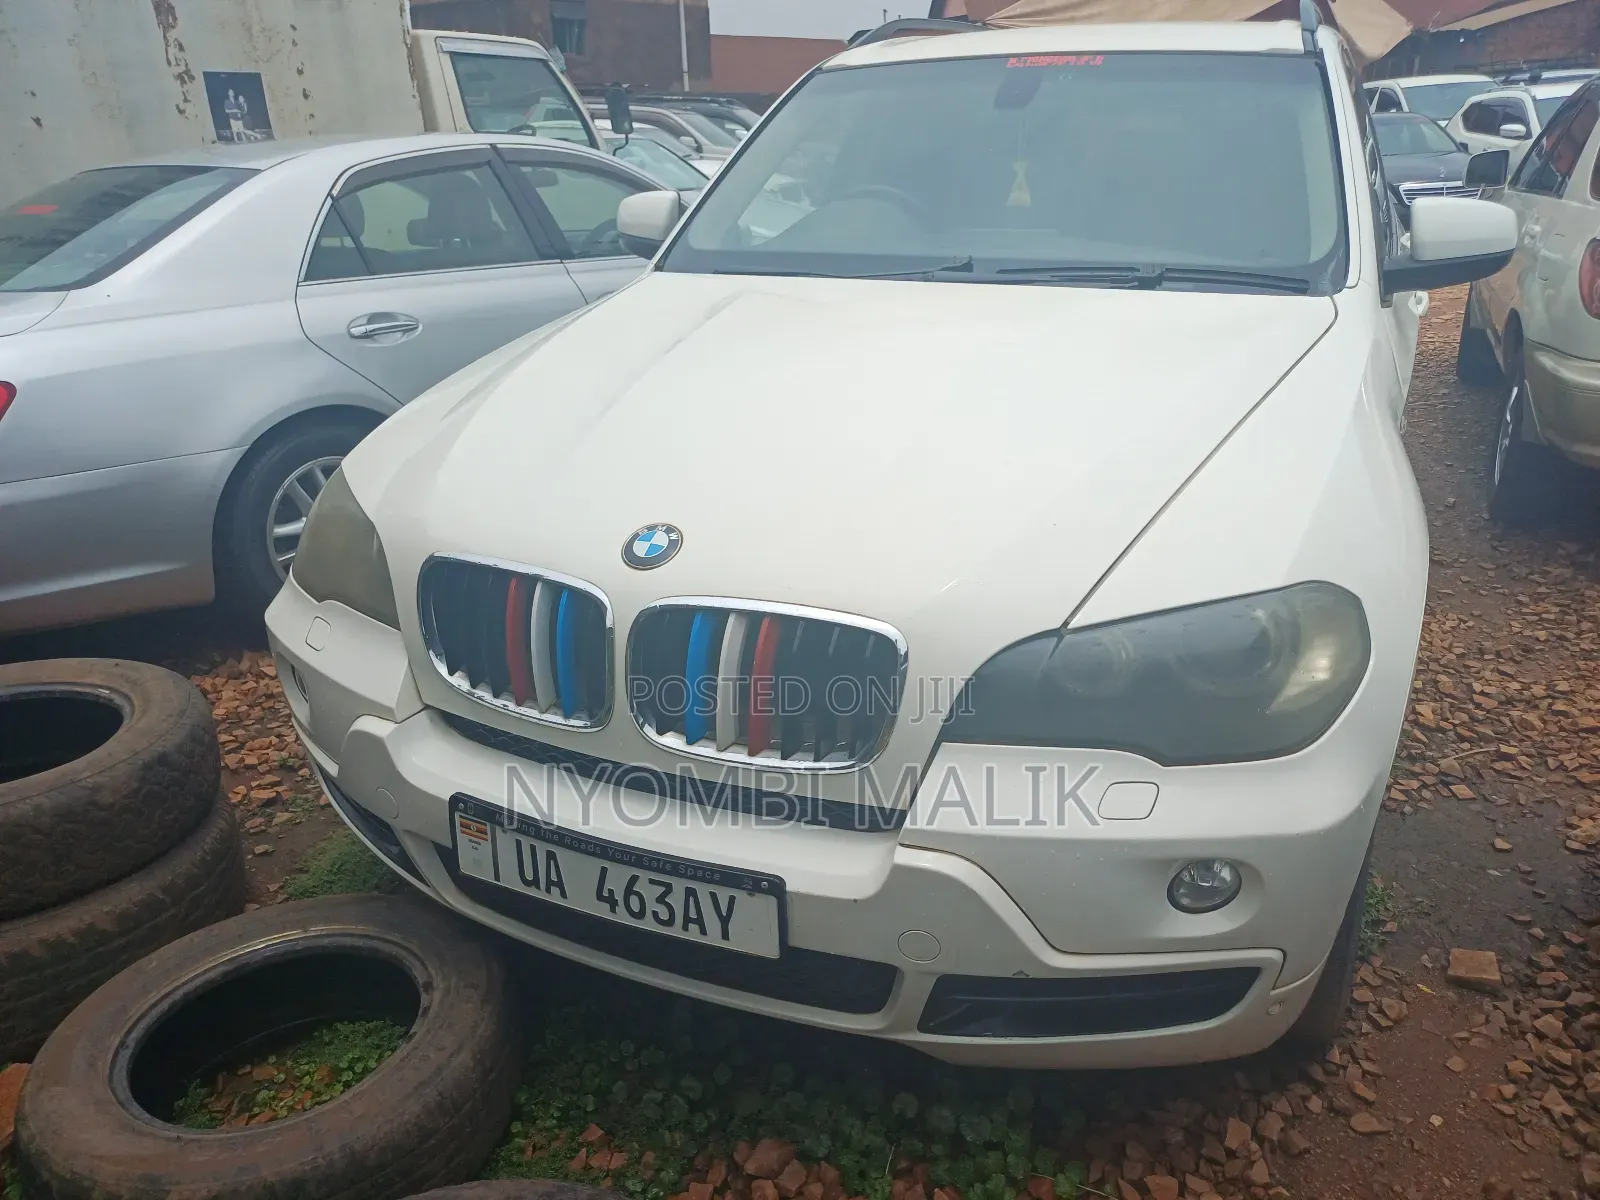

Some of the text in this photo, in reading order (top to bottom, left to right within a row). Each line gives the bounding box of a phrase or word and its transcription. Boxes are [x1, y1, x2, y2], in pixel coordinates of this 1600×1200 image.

[495, 812, 722, 881] Ming the Roads Your Safe Space
[515, 838, 737, 942] UA 463AY
